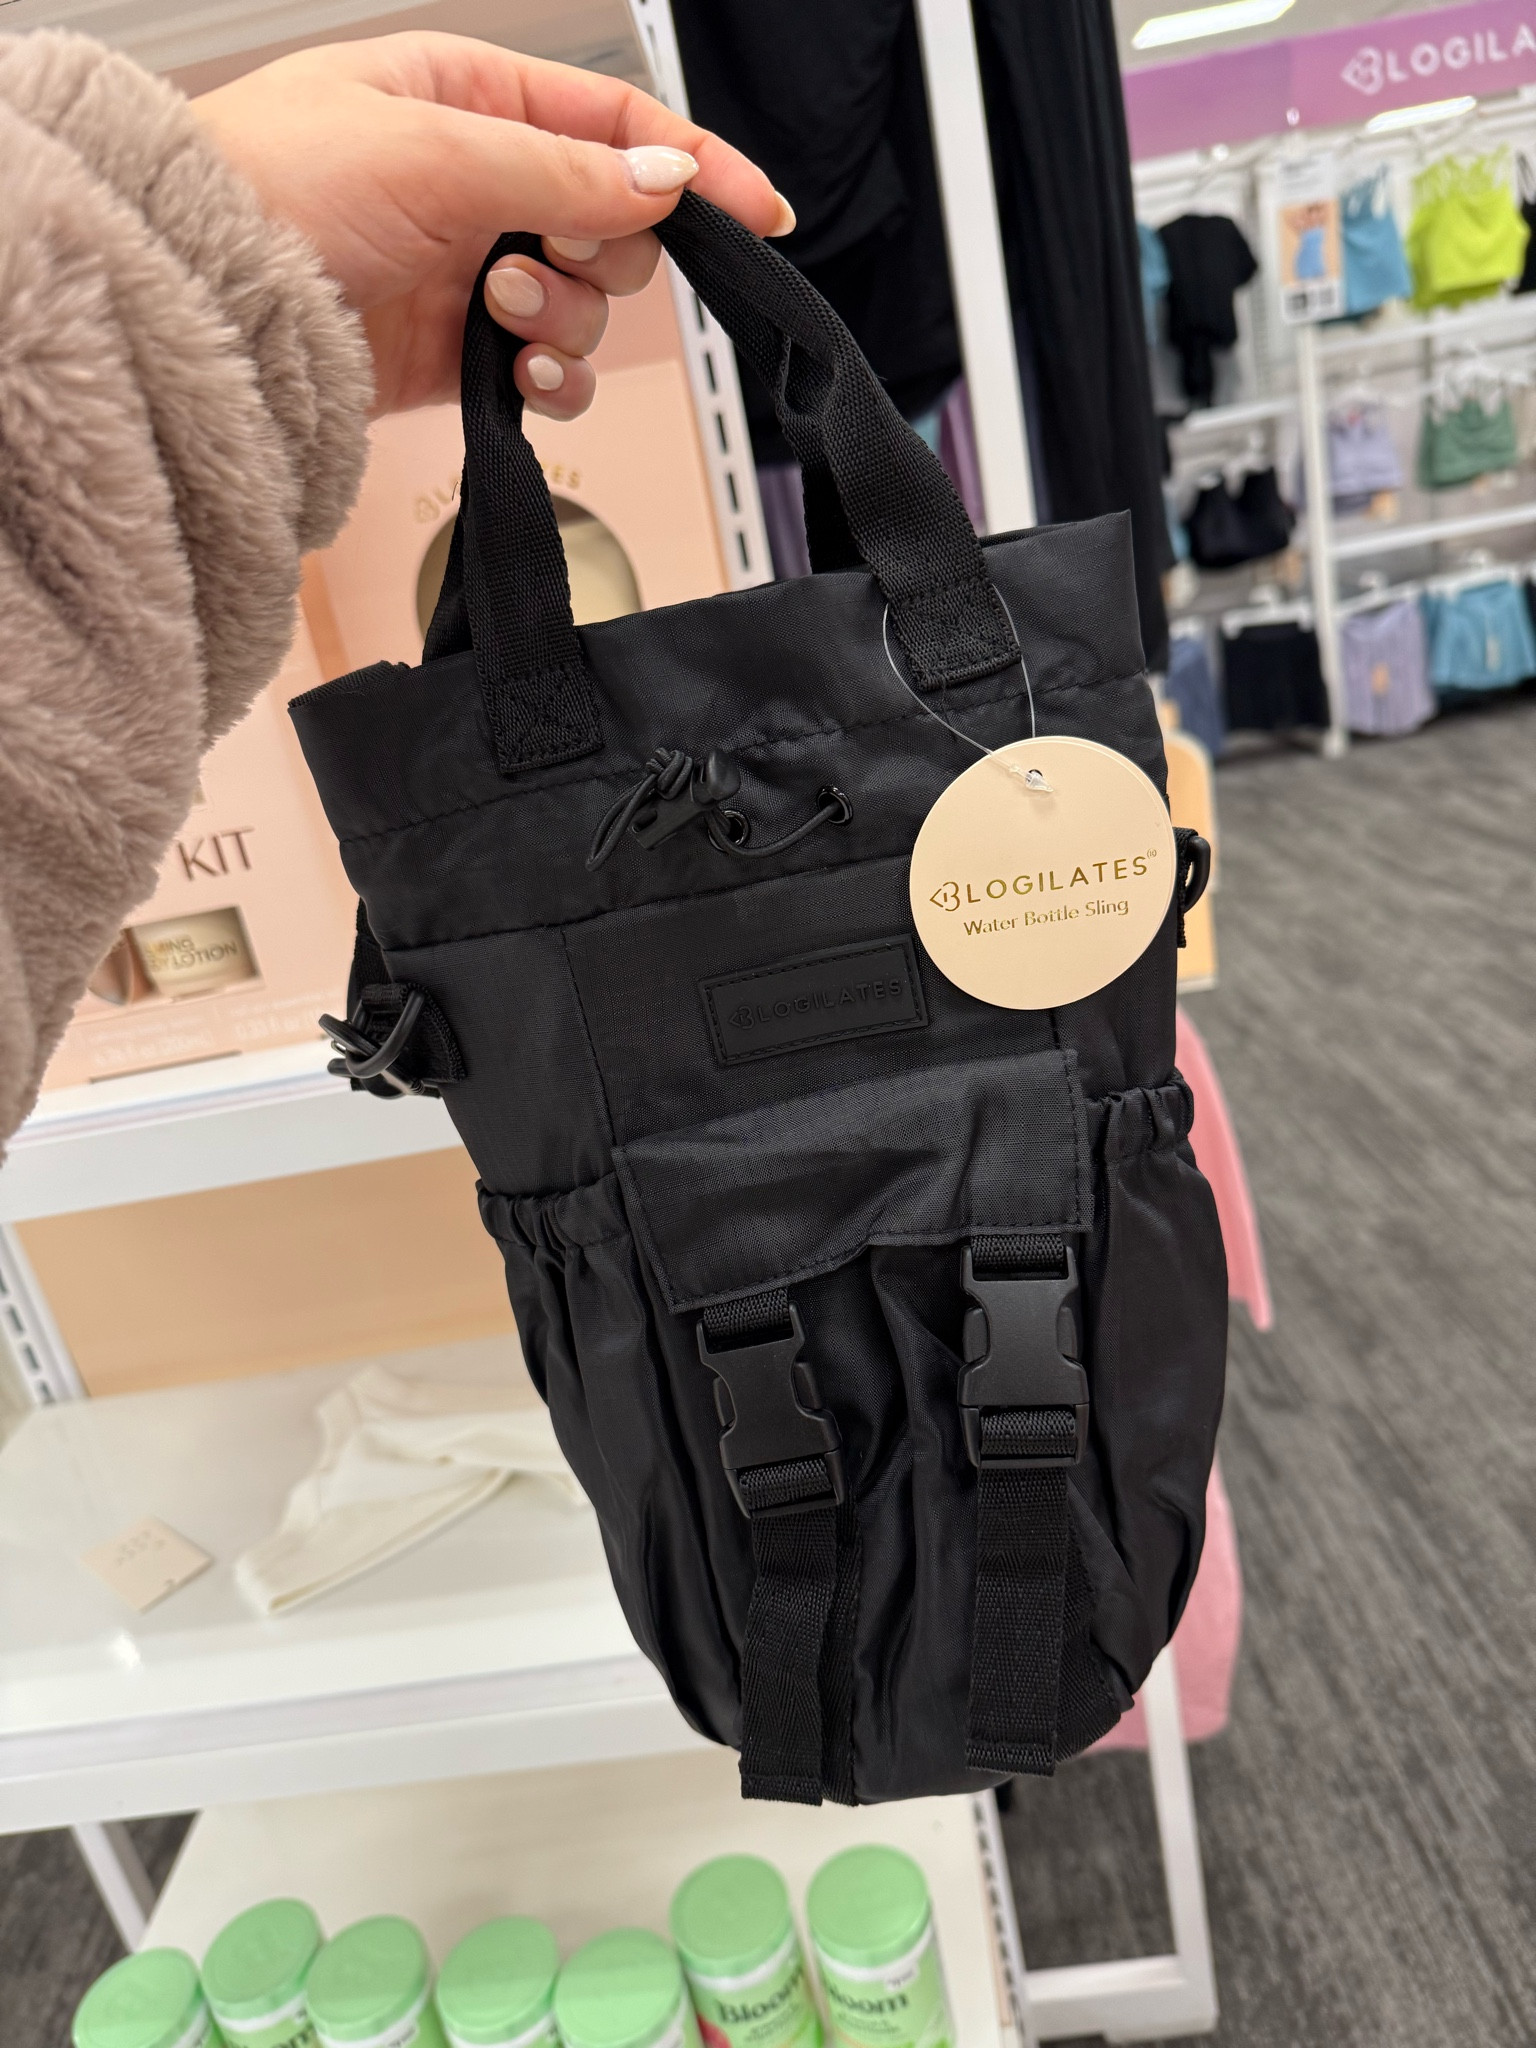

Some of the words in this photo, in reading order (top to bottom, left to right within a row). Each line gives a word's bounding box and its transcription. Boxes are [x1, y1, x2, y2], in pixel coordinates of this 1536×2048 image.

[178, 826, 255, 881] KIT
[963, 918, 1019, 936] Water
[1024, 905, 1080, 927] Bottle
[1085, 899, 1130, 917] Sling
[172, 941, 238, 970] LOTION
[729, 978, 903, 1030] BLOGILATES
